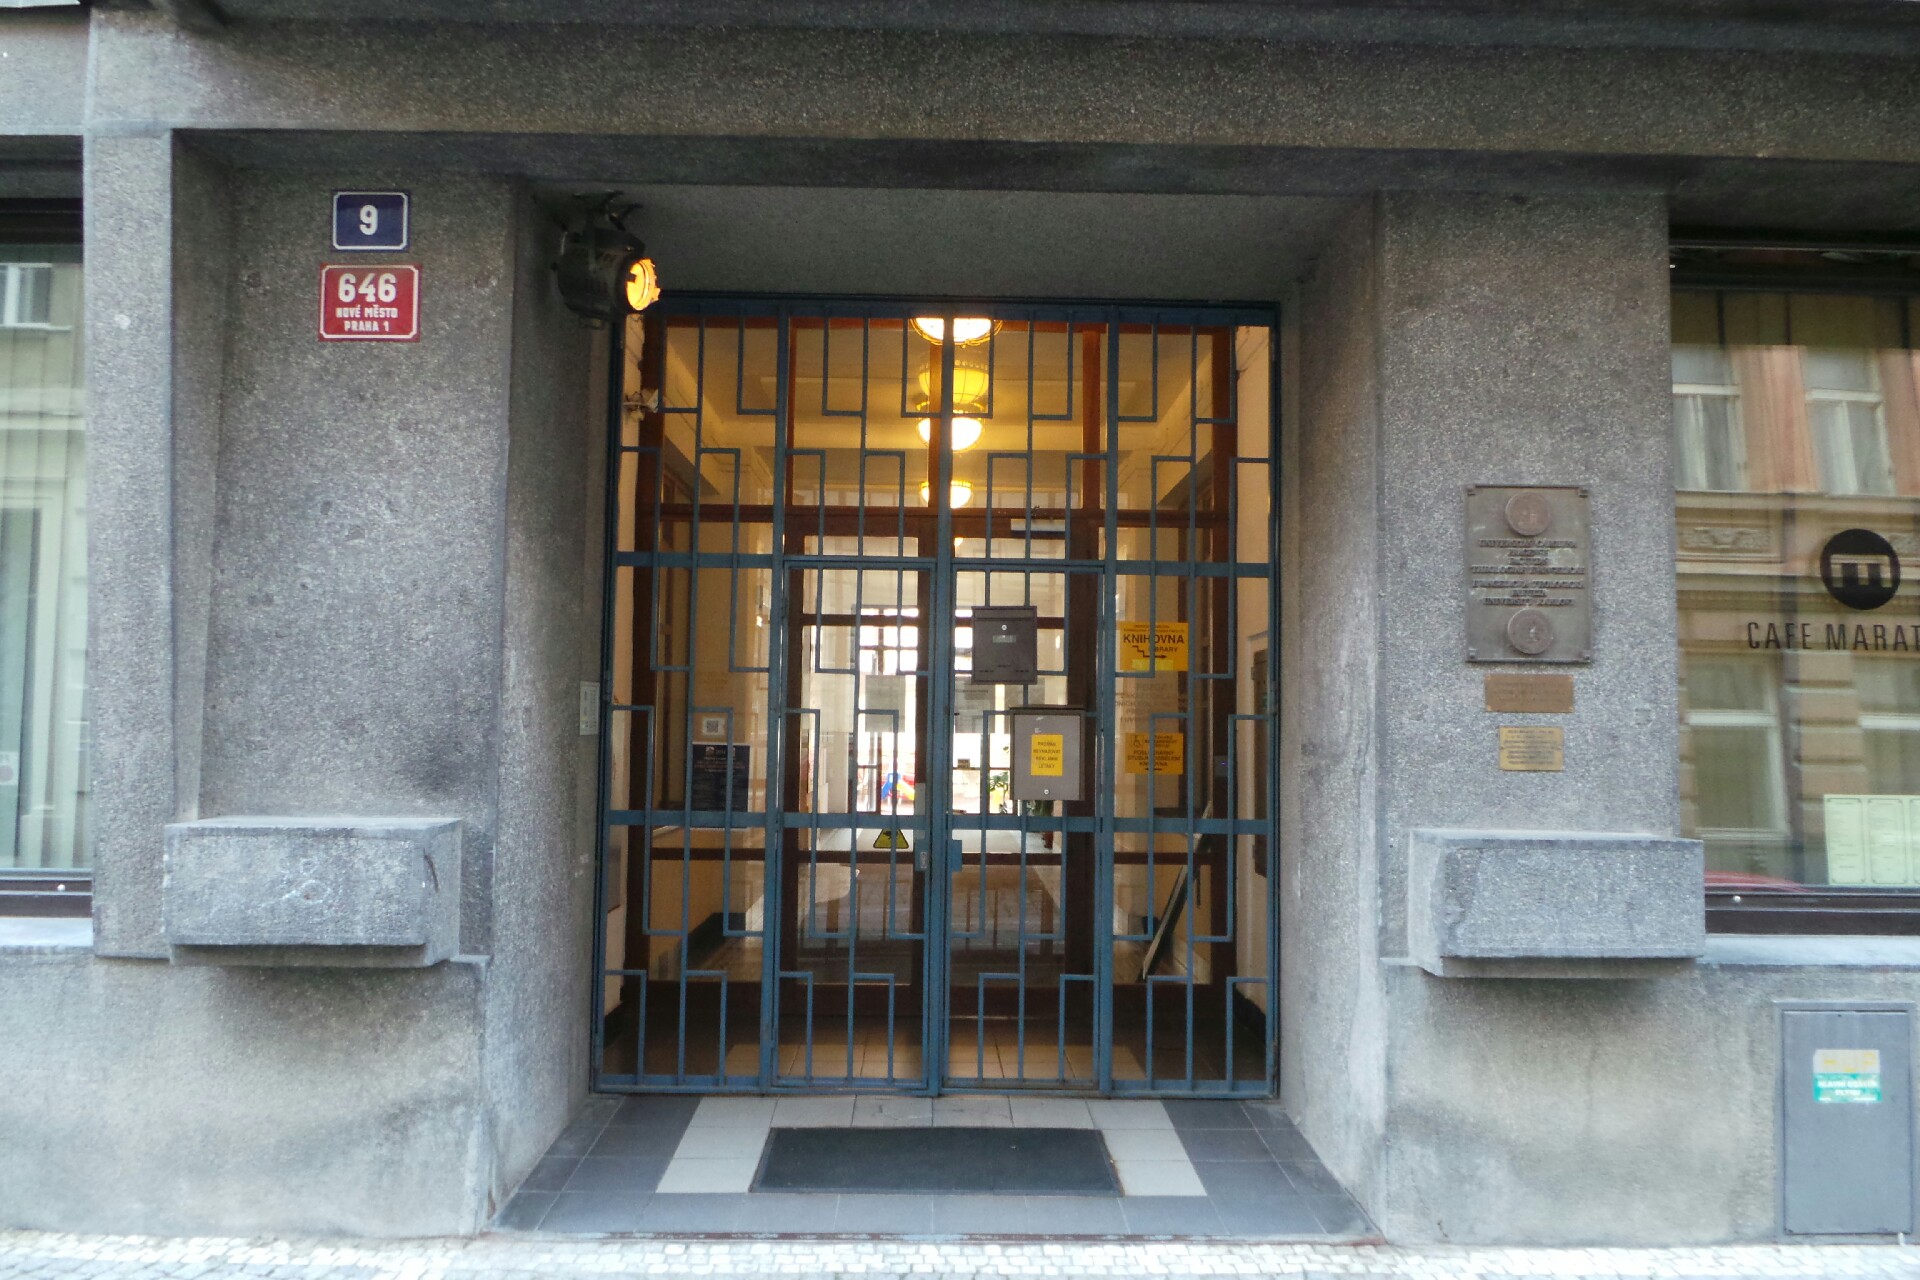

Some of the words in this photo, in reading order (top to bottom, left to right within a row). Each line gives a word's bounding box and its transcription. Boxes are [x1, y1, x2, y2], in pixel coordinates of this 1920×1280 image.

[359, 204, 378, 236] 9
[338, 272, 397, 303] 646
[335, 304, 361, 318] NOVÉ
[364, 304, 398, 318] MĚSTO
[344, 320, 379, 332] PRAHA
[383, 320, 389, 332] 1
[1747, 622, 1812, 650] CAFE
[1825, 623, 1920, 652] MARAT
